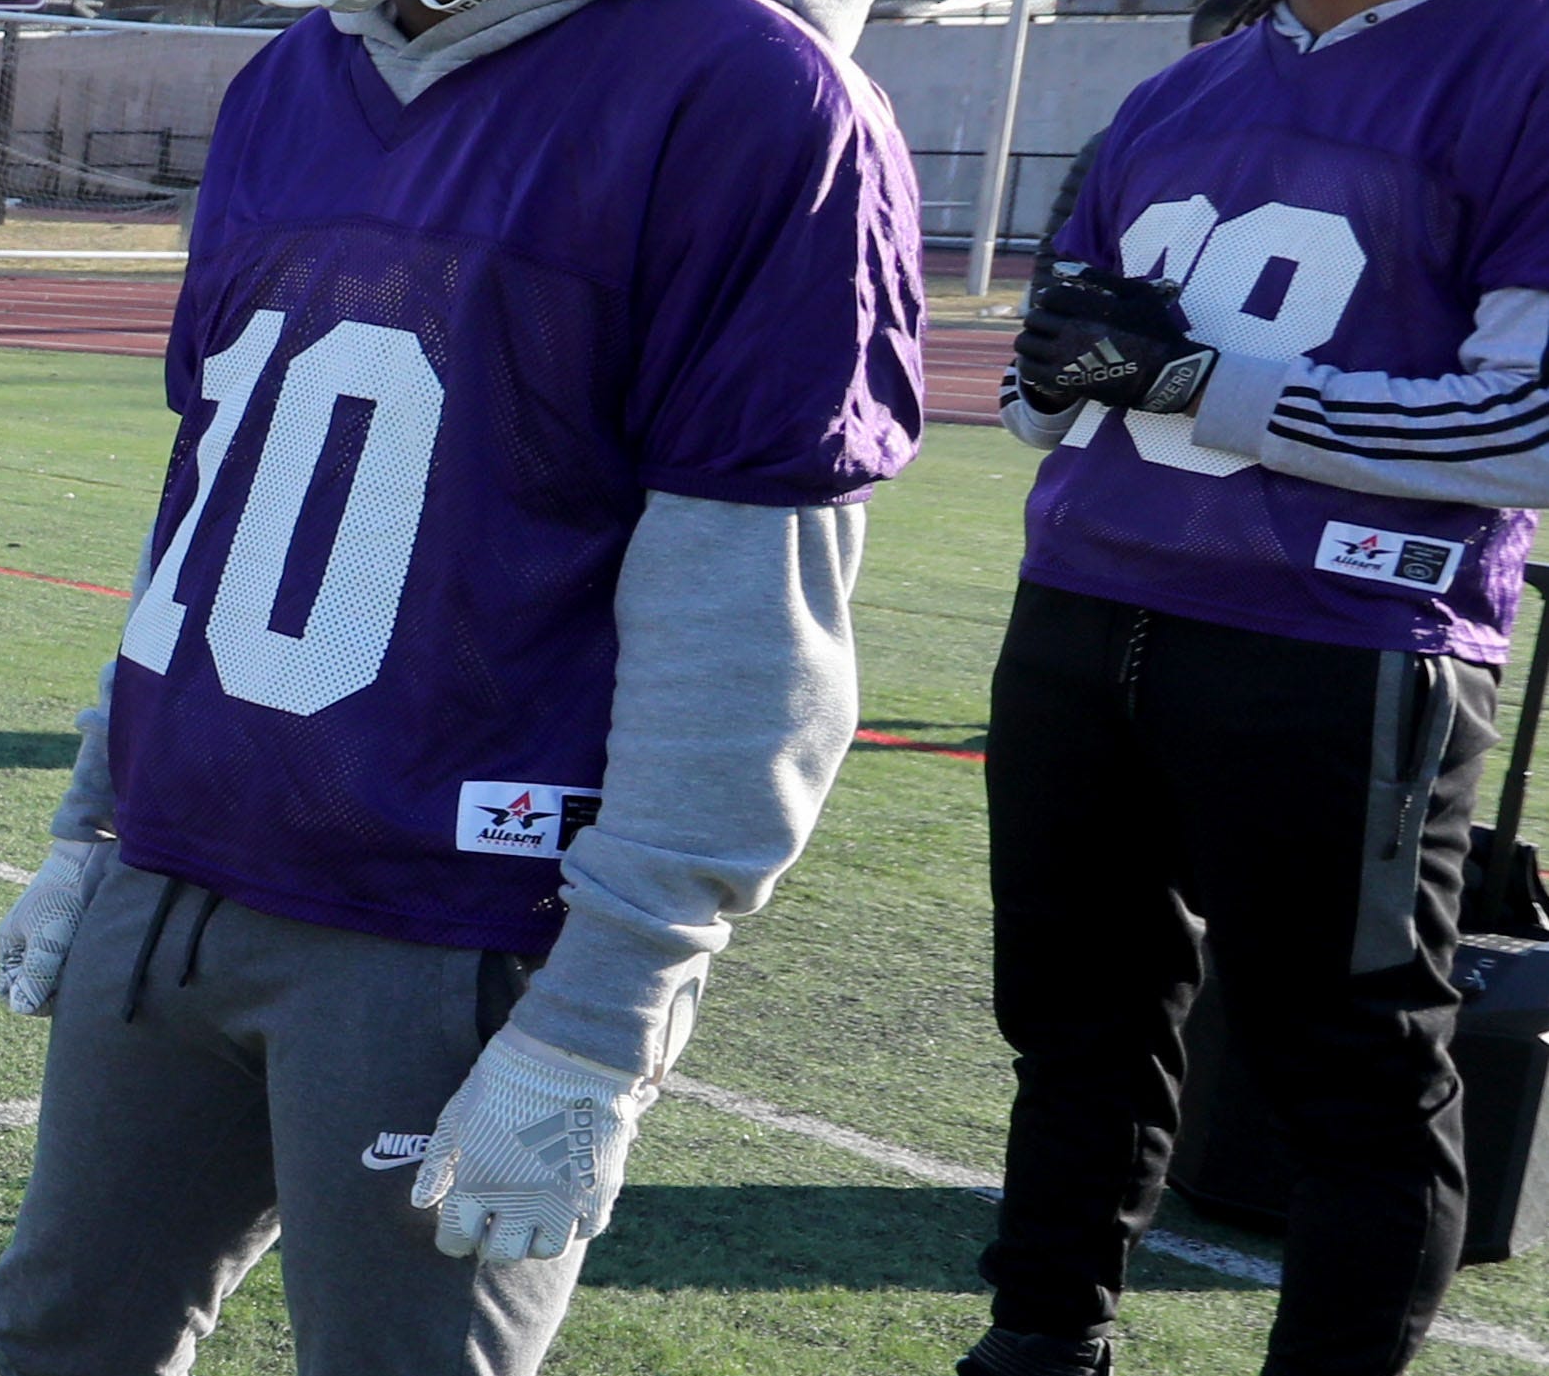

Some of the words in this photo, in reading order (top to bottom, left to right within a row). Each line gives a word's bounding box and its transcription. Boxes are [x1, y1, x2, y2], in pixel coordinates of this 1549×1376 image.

[1055, 361, 1139, 386] adidas
[120, 309, 445, 717] 10
[476, 827, 543, 845] Alleson
[374, 1131, 433, 1158] NIKE
[569, 1096, 596, 1189] adidas
